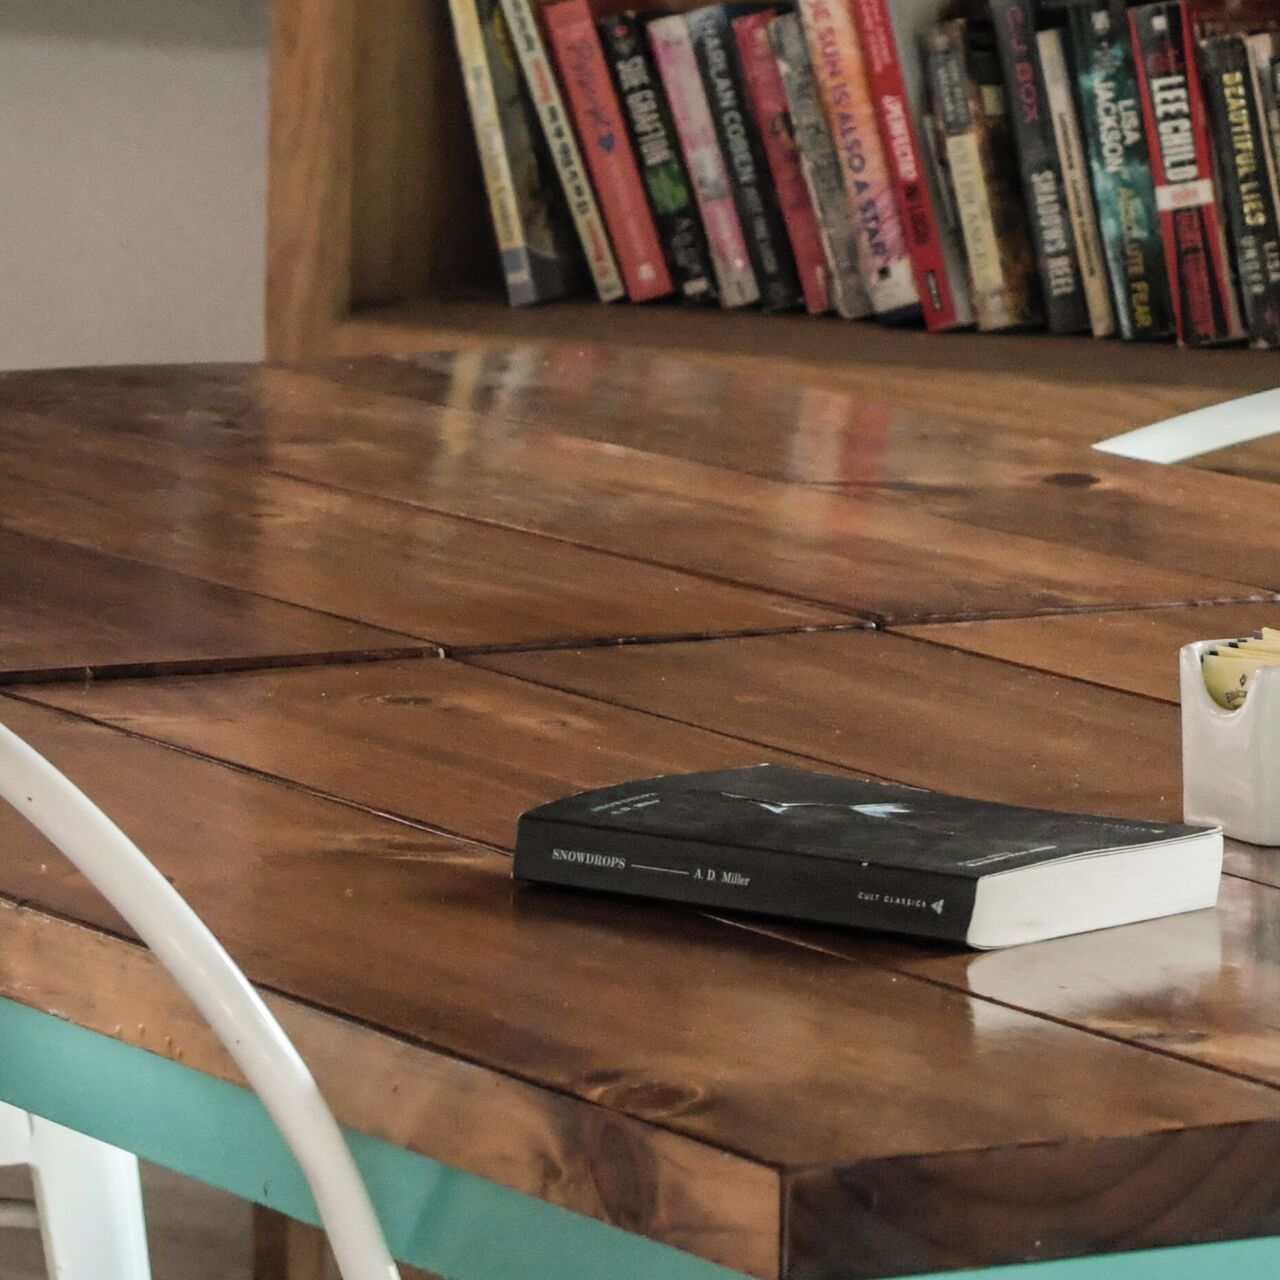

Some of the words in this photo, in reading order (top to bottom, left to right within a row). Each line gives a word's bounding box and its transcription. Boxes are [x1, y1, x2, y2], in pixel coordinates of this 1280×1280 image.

[812, 25, 844, 81] SUN
[827, 80, 851, 104] IS
[1012, 57, 1041, 124] BOX
[1149, 73, 1190, 118] LEE
[623, 86, 674, 168] GRAFTON
[719, 106, 759, 185] COBEN
[834, 110, 868, 173] ALSO
[1091, 77, 1126, 174] JACKSON
[1116, 97, 1141, 146] LISA
[1156, 115, 1200, 184] CHILD
[1221, 69, 1258, 176] BEAUTIFUL
[851, 173, 874, 195] A
[1029, 167, 1068, 253] SHADOWS
[1238, 178, 1267, 228] LIES
[855, 193, 892, 263] STAR
[1044, 252, 1075, 296] REEL
[1129, 278, 1154, 328] FEAR
[552, 848, 626, 870] SNOWDROPS
[721, 871, 751, 887] Miller
[857, 891, 881, 903] CULT
[883, 895, 928, 909] CLASSICS
